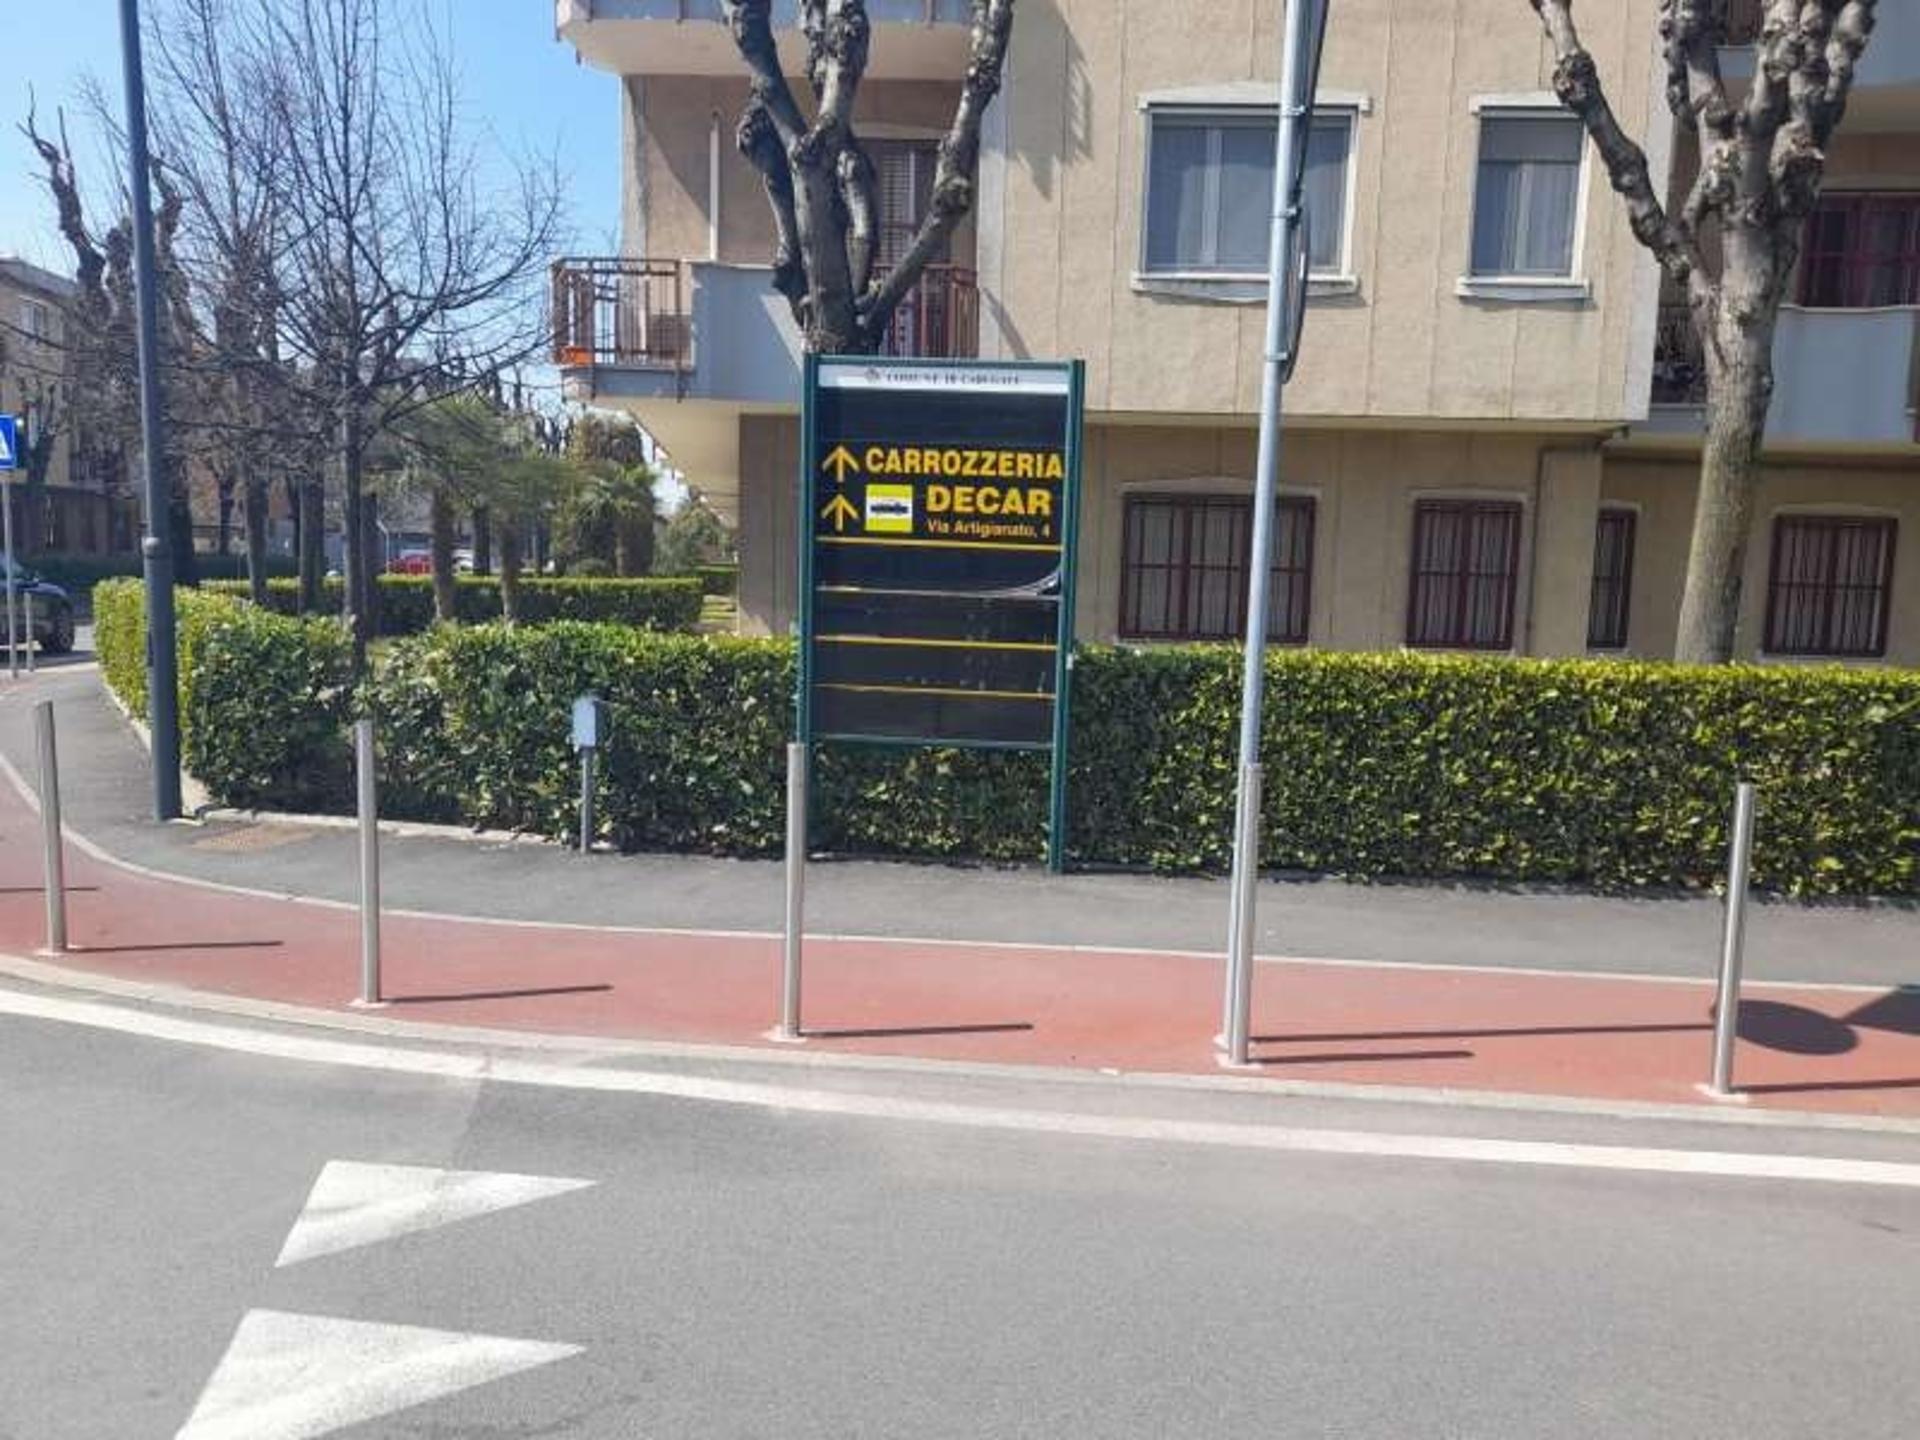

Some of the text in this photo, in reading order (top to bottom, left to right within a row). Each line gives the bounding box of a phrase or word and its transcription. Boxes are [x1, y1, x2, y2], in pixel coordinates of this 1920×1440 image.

[866, 448, 1063, 477] CARROZZERIA
[926, 484, 1051, 515] DECAR
[927, 519, 949, 534] Via
[1041, 525, 1050, 537] 4
